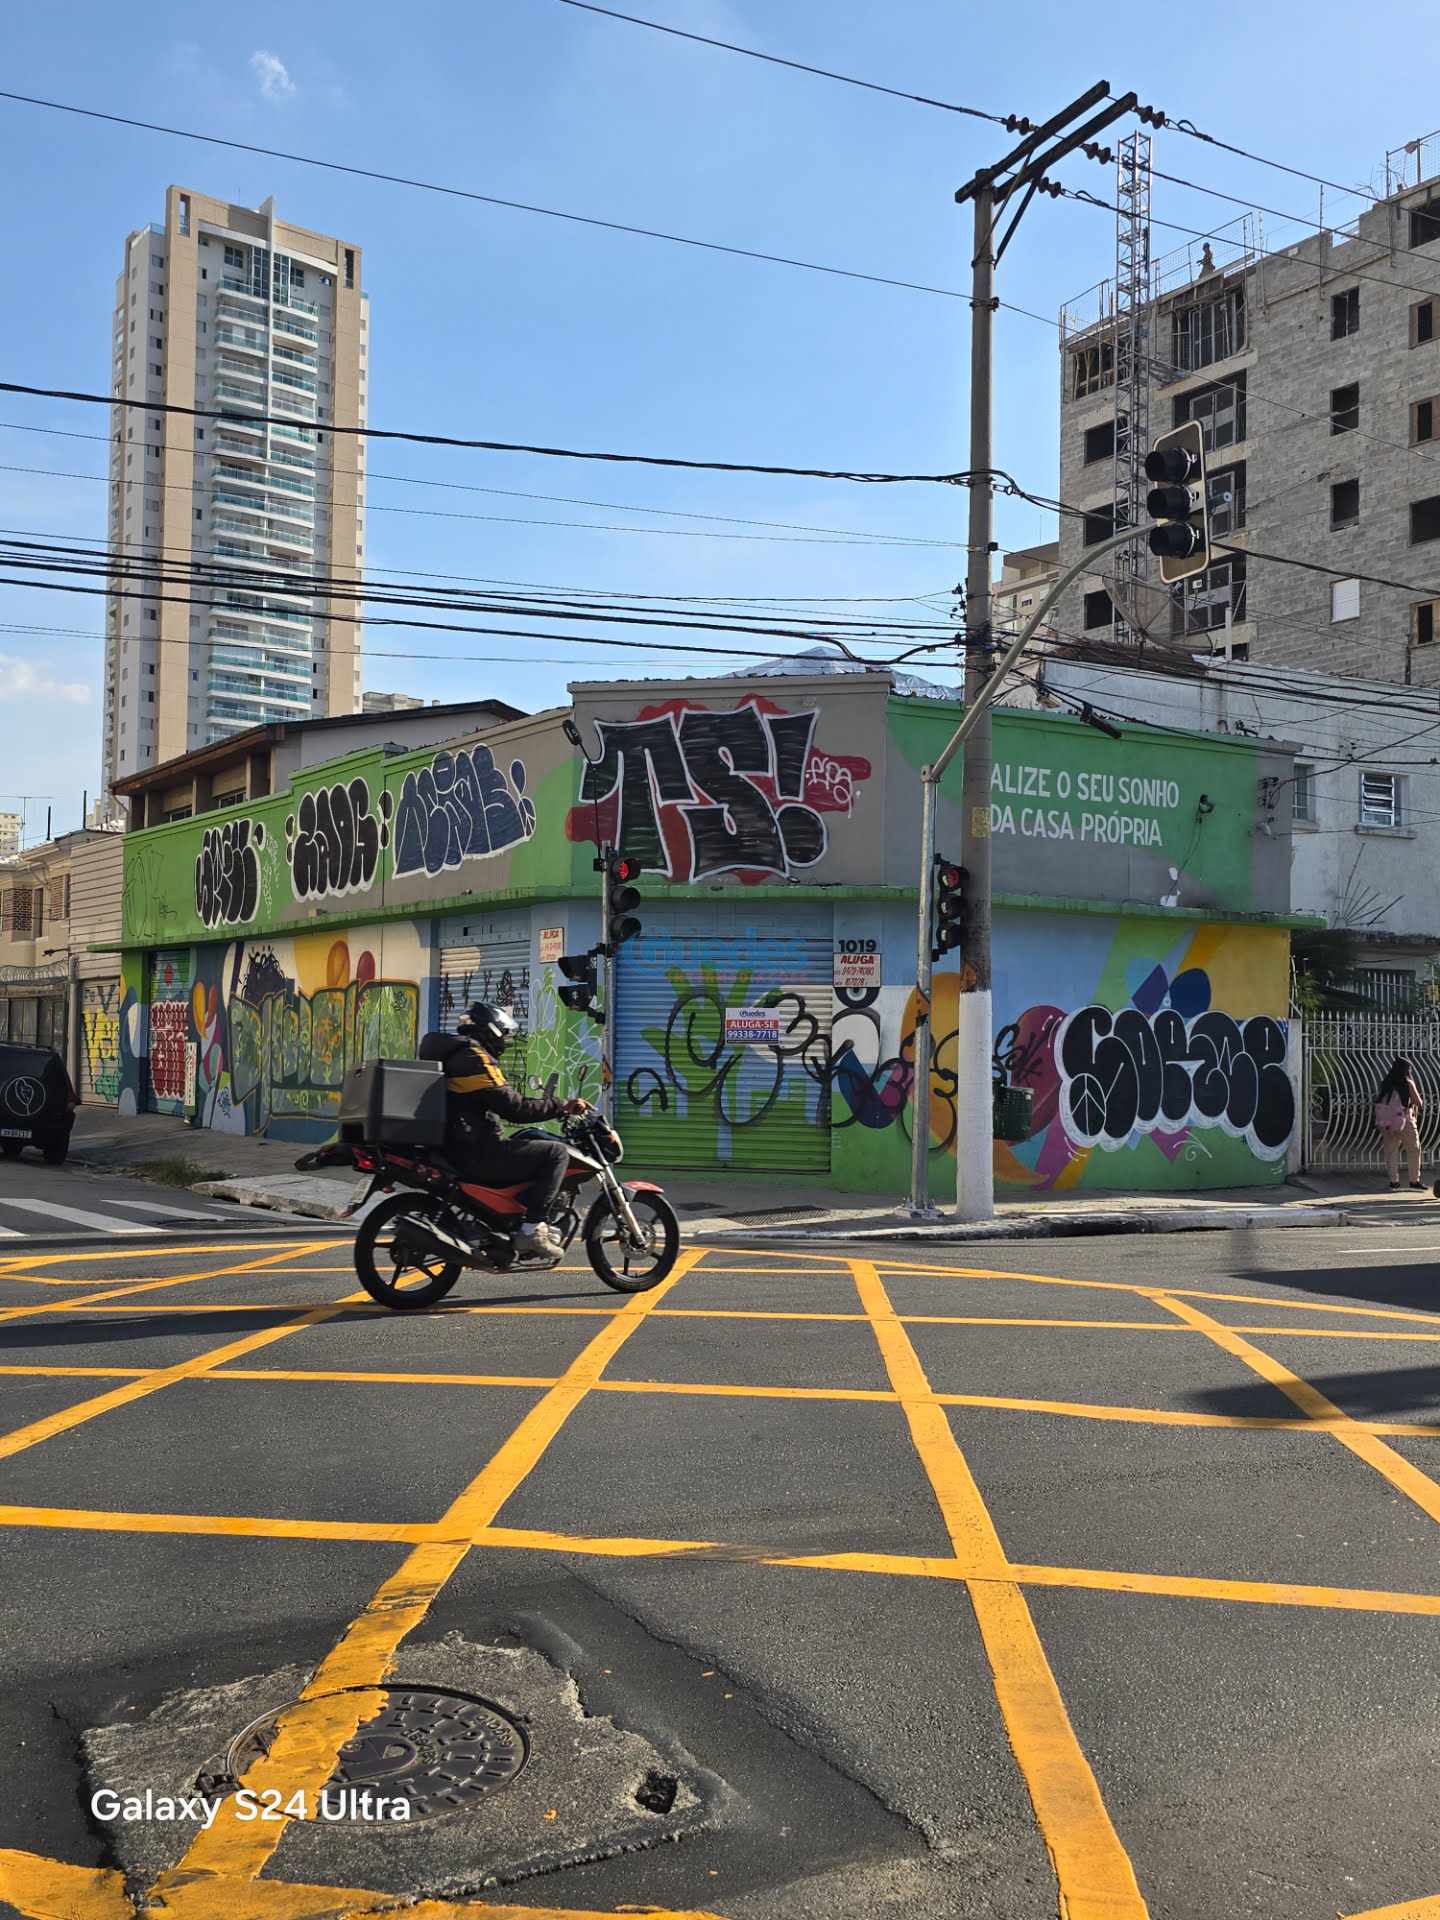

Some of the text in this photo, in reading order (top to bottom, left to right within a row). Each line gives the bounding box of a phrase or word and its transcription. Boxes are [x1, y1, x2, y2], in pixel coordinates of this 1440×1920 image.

[1057, 771, 1071, 799] O
[1077, 772, 1114, 803] SEU
[1118, 777, 1180, 808] SONHO
[1021, 807, 1075, 841] CASA
[1081, 810, 1163, 847] PRÓPRIA
[838, 939, 877, 953] 1019
[840, 954, 875, 965] ALUGA
[739, 1010, 766, 1018] Guedes
[730, 1020, 775, 1028] ALUGA-SE
[727, 1030, 778, 1038] 99338-7718
